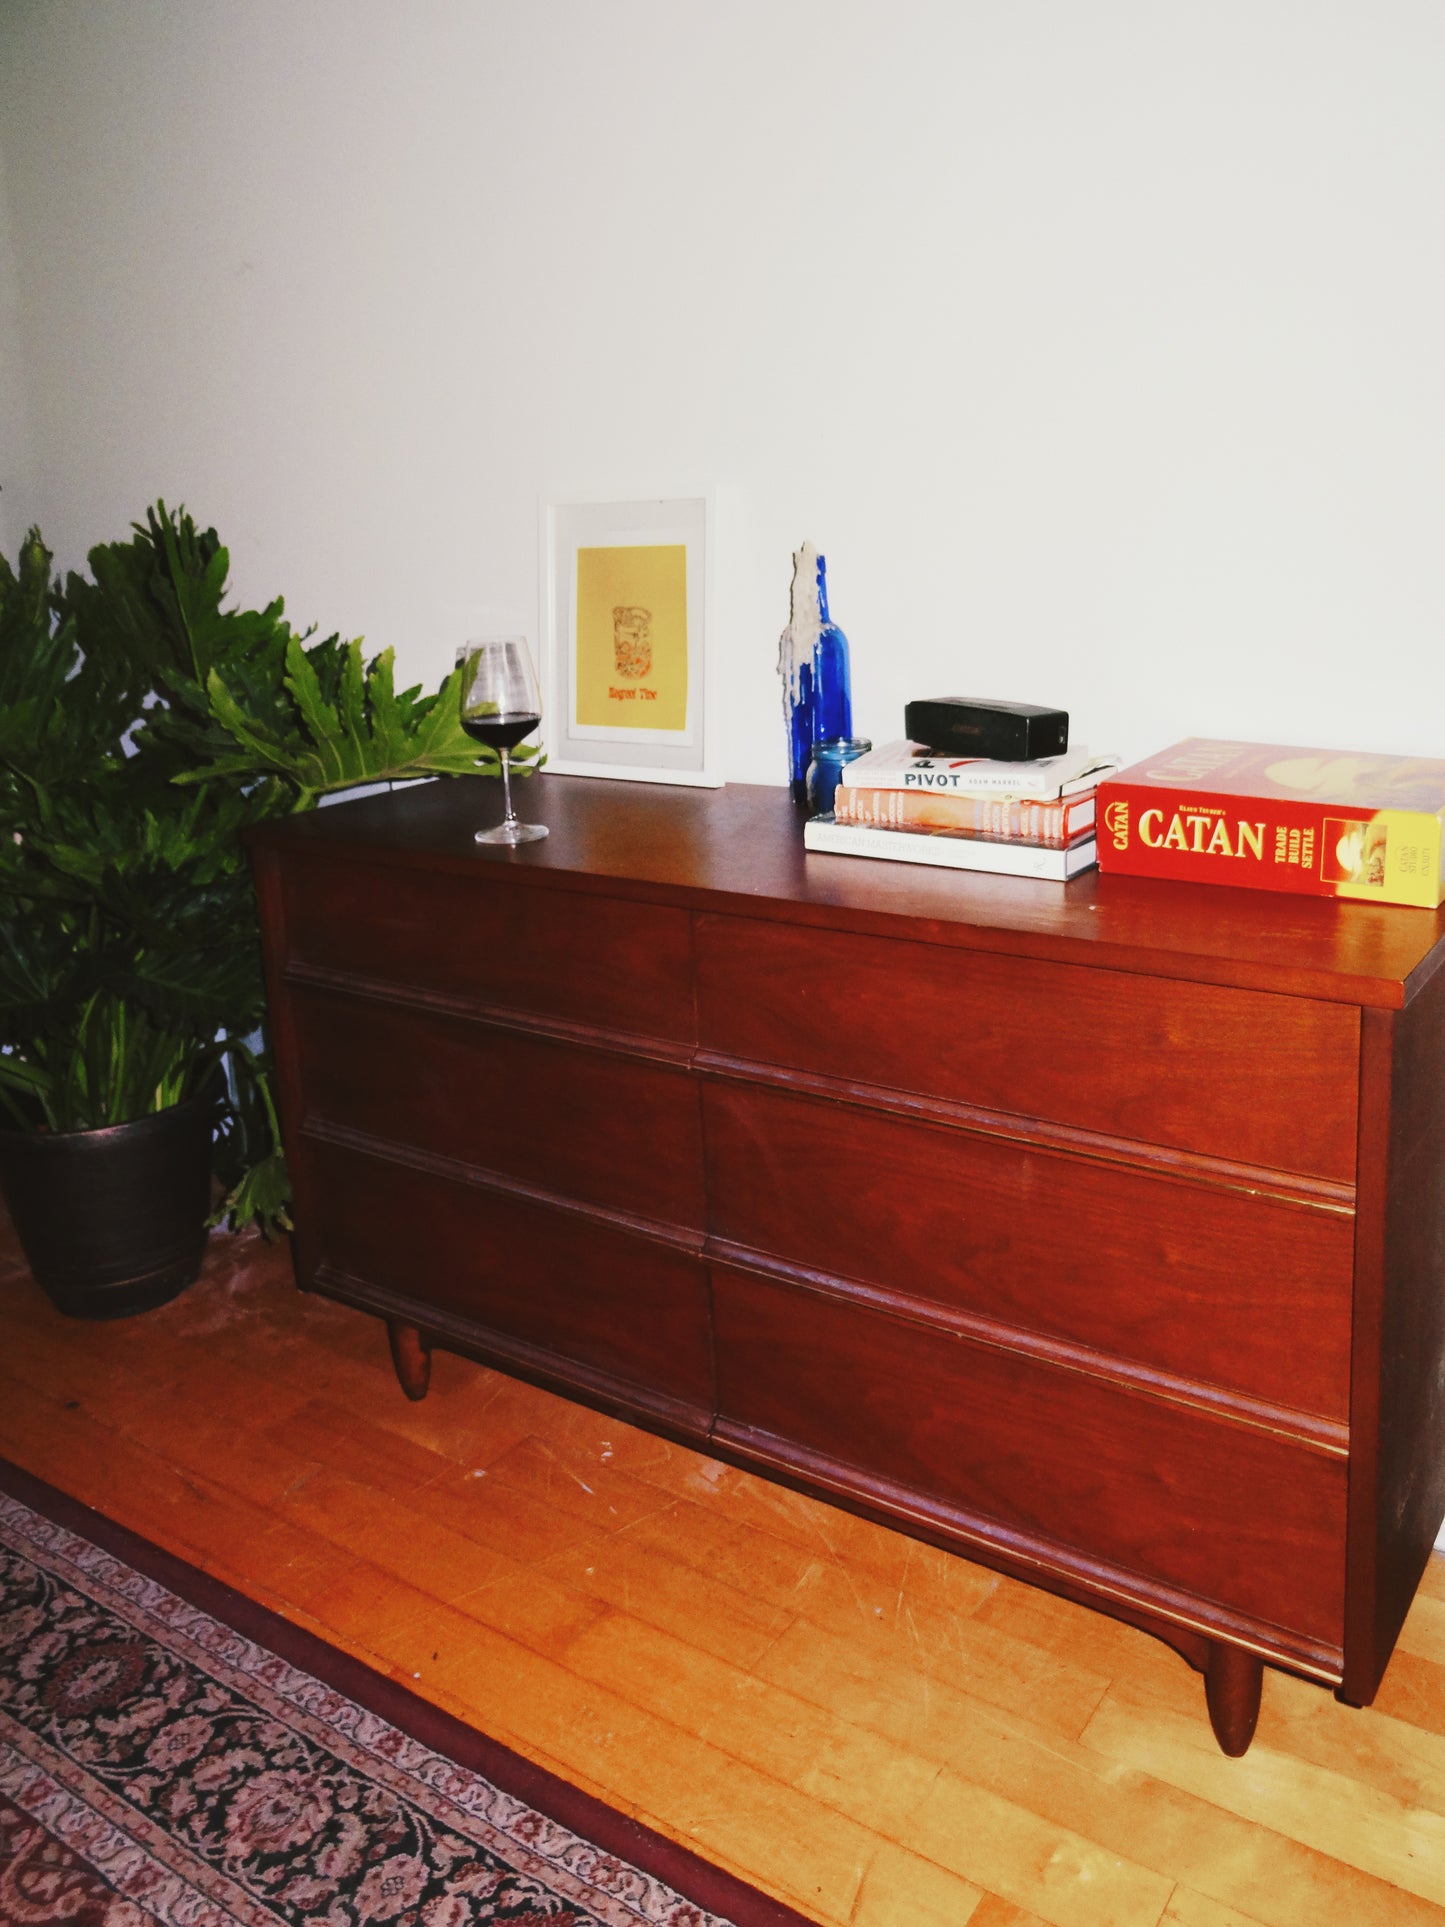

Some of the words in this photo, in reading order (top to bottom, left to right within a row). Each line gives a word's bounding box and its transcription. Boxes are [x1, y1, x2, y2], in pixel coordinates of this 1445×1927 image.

[904, 773, 961, 787] PIVOT
[816, 832, 866, 849] AMERICAN
[1112, 800, 1129, 851] CATAN
[1138, 808, 1266, 861] CATAN
[1274, 825, 1288, 864] TRADE
[1288, 828, 1301, 865] BUILD
[1301, 826, 1315, 870] SETTLE
